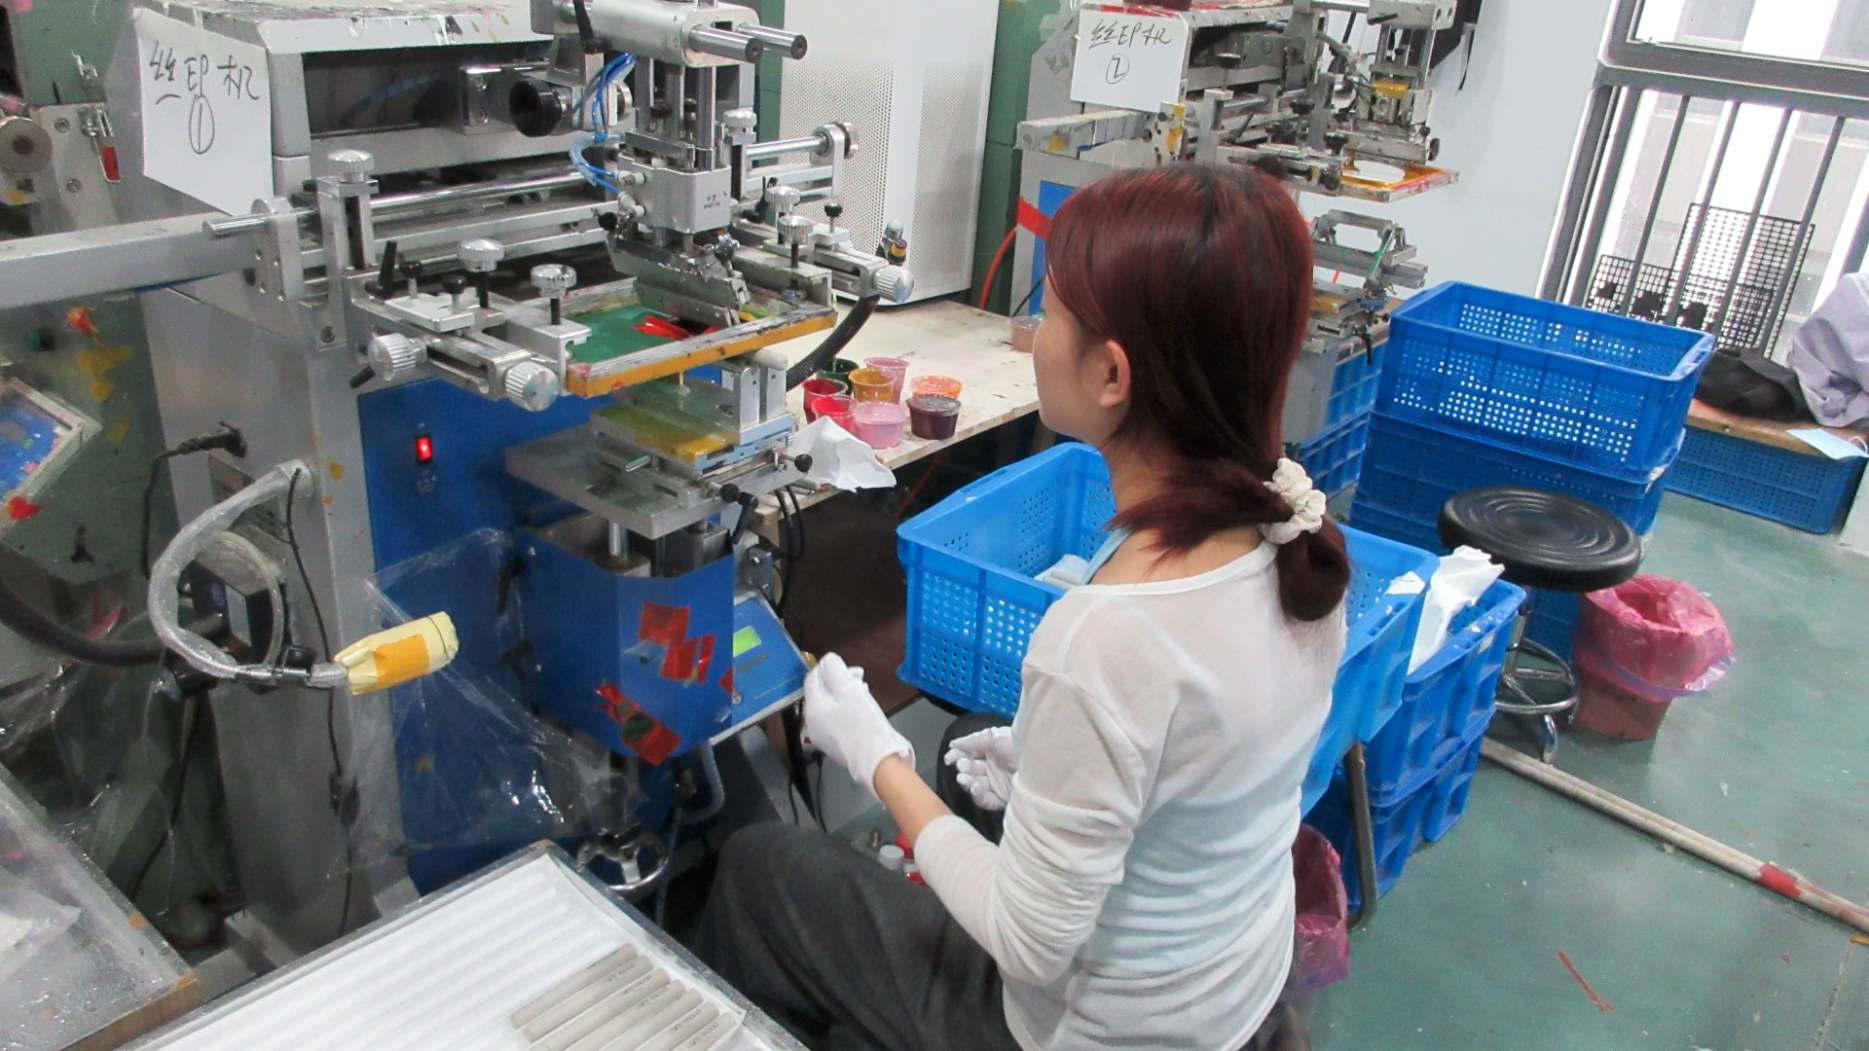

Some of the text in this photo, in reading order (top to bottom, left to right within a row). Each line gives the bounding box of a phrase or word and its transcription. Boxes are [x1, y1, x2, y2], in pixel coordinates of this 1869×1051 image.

[1088, 20, 1173, 49] 丝印机
[149, 40, 261, 105] 丝印机
